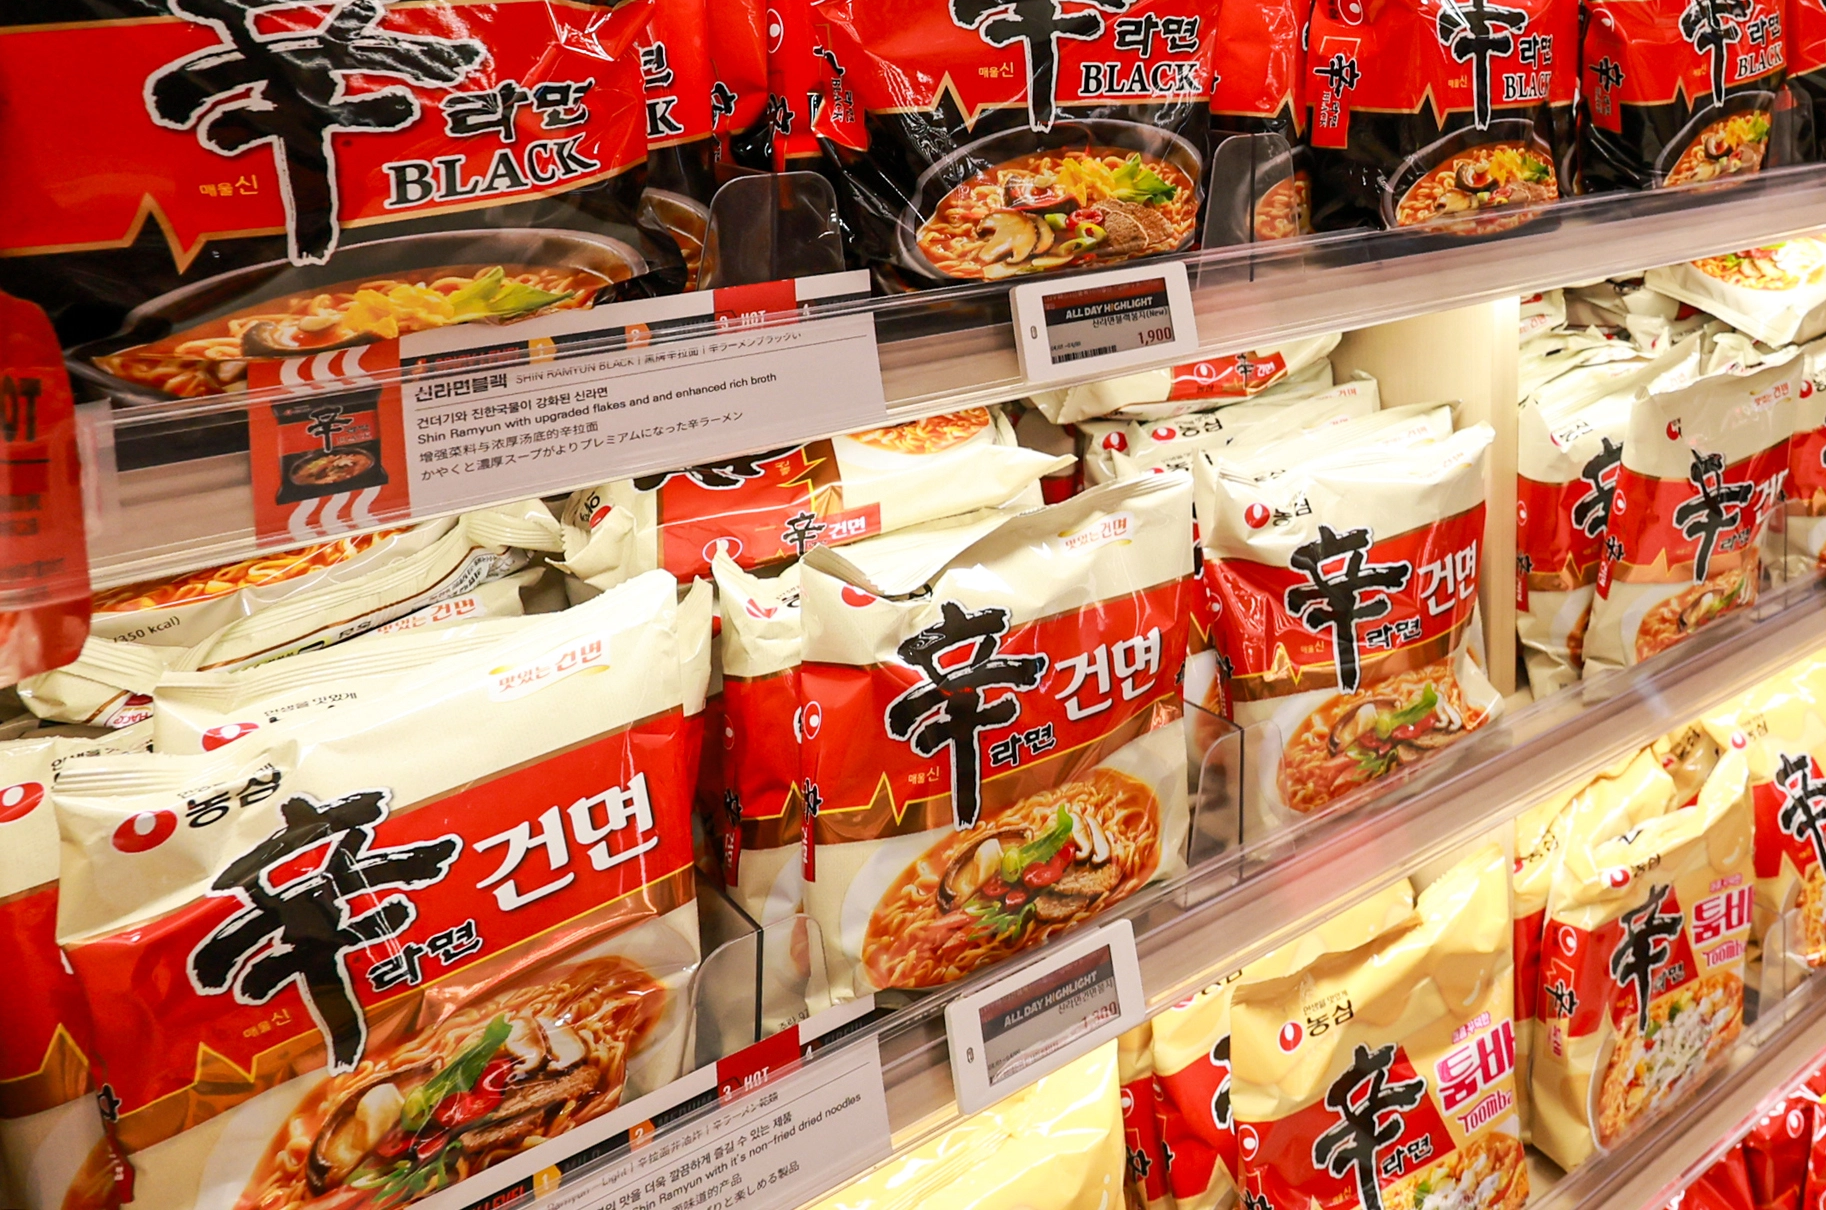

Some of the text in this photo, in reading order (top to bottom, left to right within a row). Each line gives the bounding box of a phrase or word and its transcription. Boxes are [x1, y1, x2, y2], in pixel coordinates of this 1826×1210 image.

[1113, 13, 1201, 59] 라면
[1746, 13, 1782, 47] 라면
[1076, 59, 1203, 98] BLACK
[1736, 41, 1784, 80] BLACK
[443, 75, 596, 143] 라면
[381, 136, 602, 210] BLACK
[1065, 296, 1154, 320] ALL DAY HIGHLIGHT
[1137, 326, 1173, 346] 1,900
[414, 373, 508, 403] 신라면블랙
[416, 386, 609, 430] 건더기와 진한국물이 강화된 신라면
[416, 373, 777, 445] Shin Ramyun with upgraded flakes and and enhanced rich broth
[305, 404, 353, 453] 辛
[827, 514, 868, 541] 건면
[1100, 512, 1134, 541] 건면
[1673, 447, 1753, 585] 辛
[1416, 538, 1478, 614] 건면
[147, 614, 182, 637] kcal)
[1283, 523, 1412, 695] 辛
[1364, 617, 1423, 649] 라면
[1052, 625, 1164, 722] 건면
[885, 600, 1049, 832] 辛
[987, 721, 1058, 769] 라면
[183, 764, 284, 831] 농심
[474, 770, 662, 914] 건면
[186, 786, 464, 1079] 辛
[366, 918, 484, 991] 라면
[1610, 882, 1686, 1036] 辛
[1003, 1011, 1024, 1028] ALL
[1023, 1000, 1045, 1018] DAY
[1044, 969, 1099, 1007] HIGHLIGHT
[1305, 999, 1355, 1039] 농심
[743, 1066, 770, 1092] HOT
[1433, 1017, 1516, 1117] 툼바
[658, 1175, 704, 1205] Ramyun
[704, 1162, 728, 1181] with
[730, 1153, 747, 1170] it's
[748, 1124, 797, 1159] non-fried
[798, 1112, 824, 1131] dried
[824, 1093, 862, 1119] noodles
[669, 1111, 793, 1182] 깔끔하게 즐길 있는 제품
[1311, 1041, 1428, 1210] 辛
[1381, 1134, 1434, 1177] 라면
